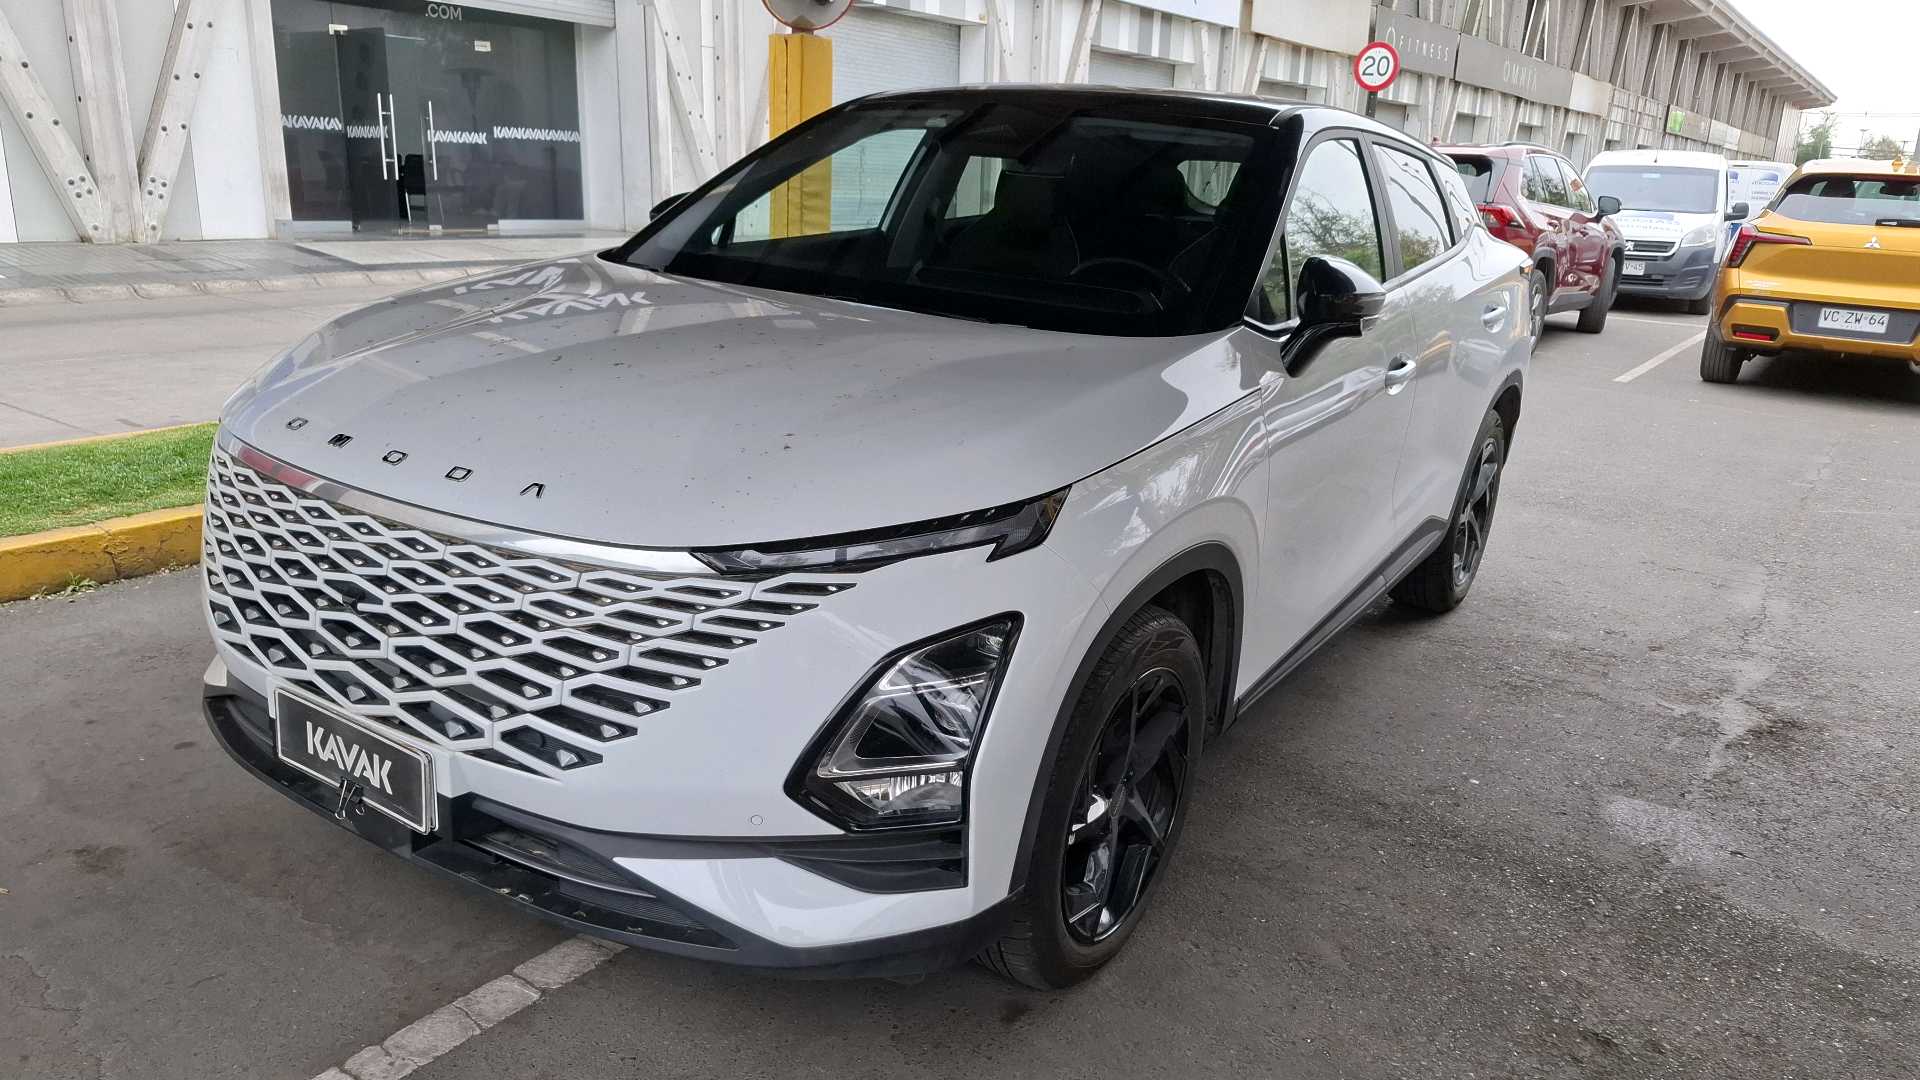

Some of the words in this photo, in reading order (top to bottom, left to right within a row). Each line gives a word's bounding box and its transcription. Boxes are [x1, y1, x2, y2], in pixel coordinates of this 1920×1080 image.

[425, 4, 463, 21] .COM
[1400, 34, 1449, 62] FITNESS
[1362, 56, 1390, 76] 20
[306, 721, 393, 795] KAVAK
